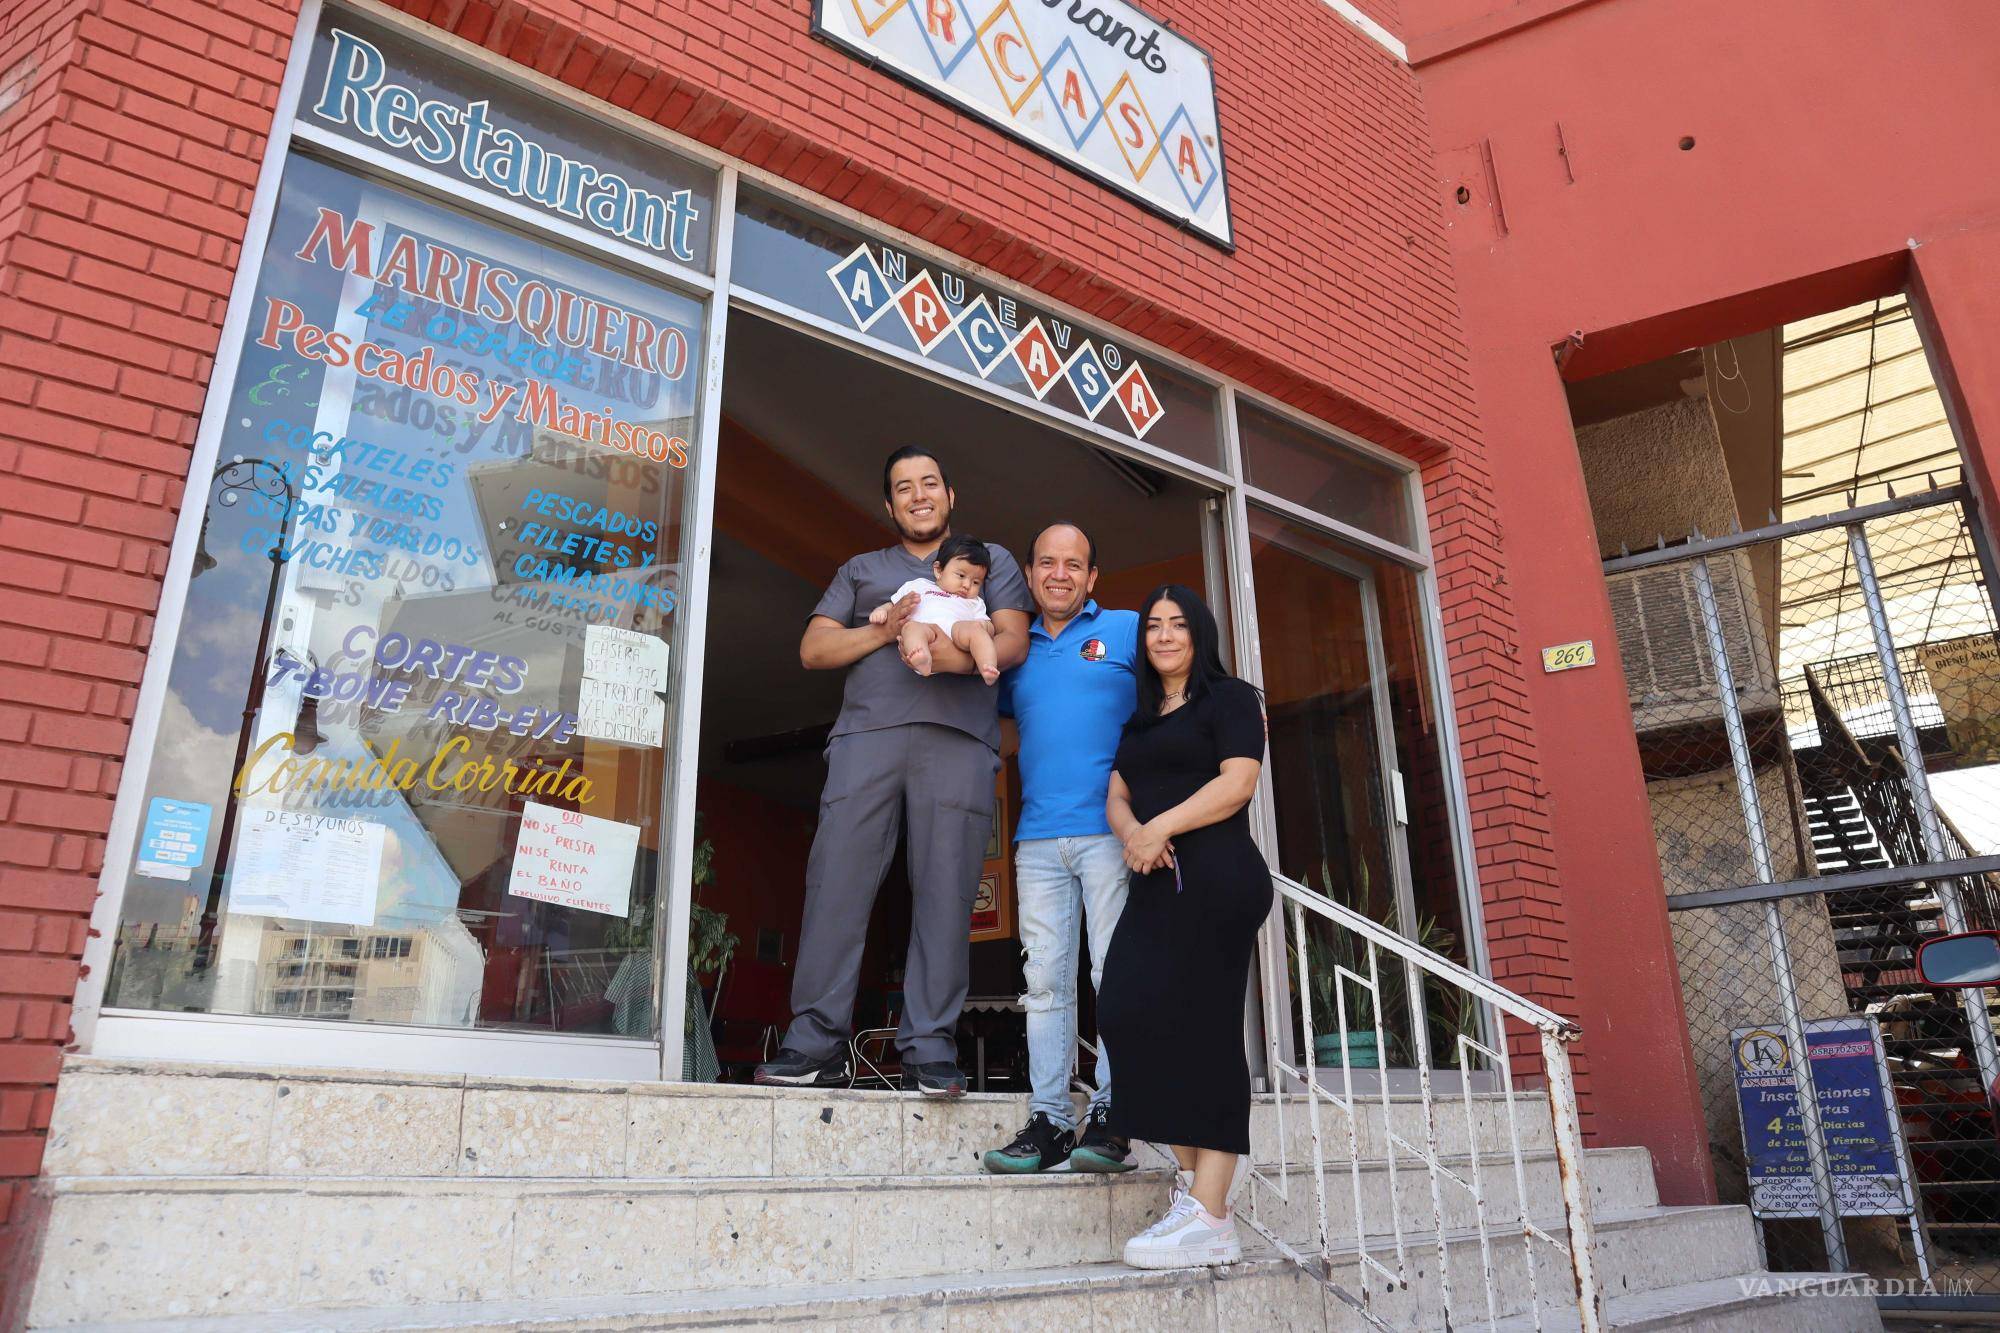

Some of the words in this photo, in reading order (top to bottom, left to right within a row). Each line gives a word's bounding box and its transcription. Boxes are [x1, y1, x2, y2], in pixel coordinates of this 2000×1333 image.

[313, 28, 698, 261] Restaurant
[295, 208, 688, 381] MARISQUERO
[355, 294, 414, 328] LE
[883, 247, 1121, 370] NUEVO
[850, 268, 1150, 419] ARCASA
[256, 296, 479, 405] Pescados
[480, 380, 515, 423] y
[516, 378, 688, 468] Mariscos
[263, 418, 454, 489] COCKTELES
[246, 491, 341, 533] SOPAS
[370, 519, 479, 566] CALDOS
[522, 488, 658, 543] PESCADOS
[240, 527, 384, 580] CEVICHES
[518, 522, 632, 568] FILETES
[640, 551, 656, 572] Y
[514, 554, 676, 612] CAMARONES
[343, 625, 528, 694] CORTES
[1555, 646, 1585, 666] 269
[267, 657, 411, 713] T-BONE
[427, 692, 578, 744] RIB-EYE
[234, 732, 418, 797] Comida
[426, 736, 597, 803] Corrida
[264, 810, 365, 836] DESAYUNOS
[522, 819, 540, 830] NO
[543, 823, 559, 834] SE
[562, 811, 584, 825] OJO
[519, 845, 533, 856] NI
[535, 848, 549, 858] SE
[549, 859, 589, 875] RENTA
[555, 836, 596, 855] PRESTA
[513, 889, 560, 903] EXCLUSIVO
[566, 898, 612, 912] CLIENTES
[516, 870, 533, 878] EL
[537, 875, 582, 892] BAÑO
[1760, 1087, 1870, 1103] Inscciones
[1767, 1117, 1783, 1135] 4
[1785, 1139, 1808, 1147] Lun
